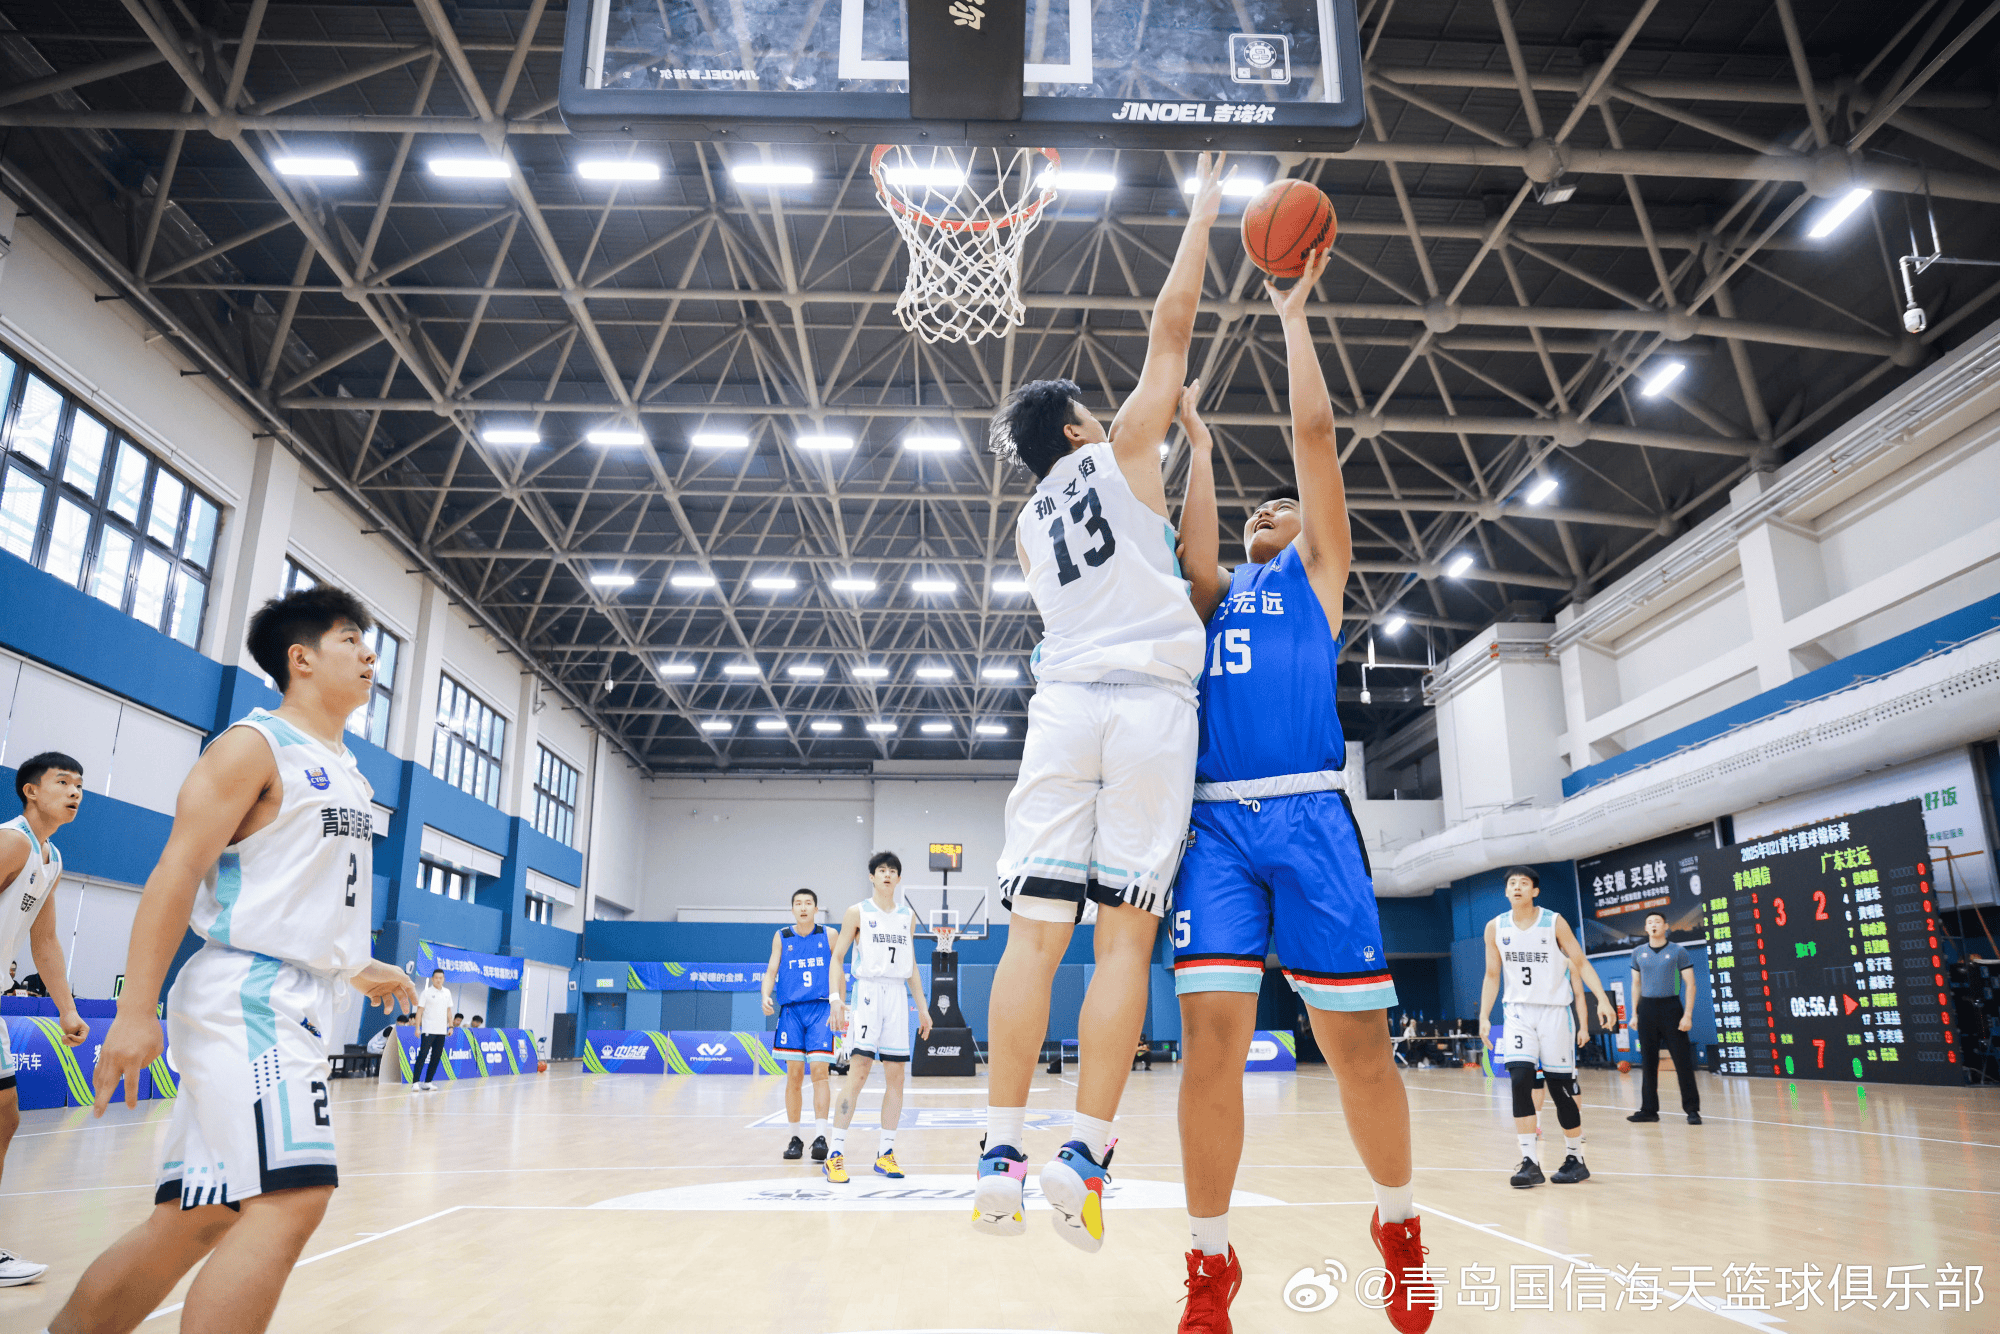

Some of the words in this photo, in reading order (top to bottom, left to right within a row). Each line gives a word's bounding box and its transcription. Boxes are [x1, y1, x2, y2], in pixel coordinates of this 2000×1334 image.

[1112, 102, 1212, 122] JINOEL
[1213, 103, 1276, 123] 吉诺尔
[1048, 487, 1116, 587] 13
[1210, 628, 1252, 677] 15
[1821, 845, 1872, 874] 广东宏远
[344, 852, 357, 907] 2
[1630, 860, 1667, 888] 买奥体
[1733, 866, 1771, 891] 青岛国信
[1840, 876, 1847, 887] 3
[1773, 897, 1787, 926] 3
[1813, 890, 1829, 920] 2
[1172, 909, 1191, 951] 5
[1926, 918, 1935, 931] 2
[788, 956, 824, 970] 广东宏远
[888, 946, 896, 964] 7
[1505, 951, 1549, 963] 青岛国信海天
[802, 971, 813, 988] 9
[1521, 966, 1532, 986] 3
[1790, 995, 1839, 1017] 08:56.4
[780, 1031, 788, 1045] 9
[861, 1025, 868, 1039] 7
[1514, 1035, 1523, 1050] 3
[1811, 1039, 1826, 1069] 7
[311, 1081, 330, 1126] 2
